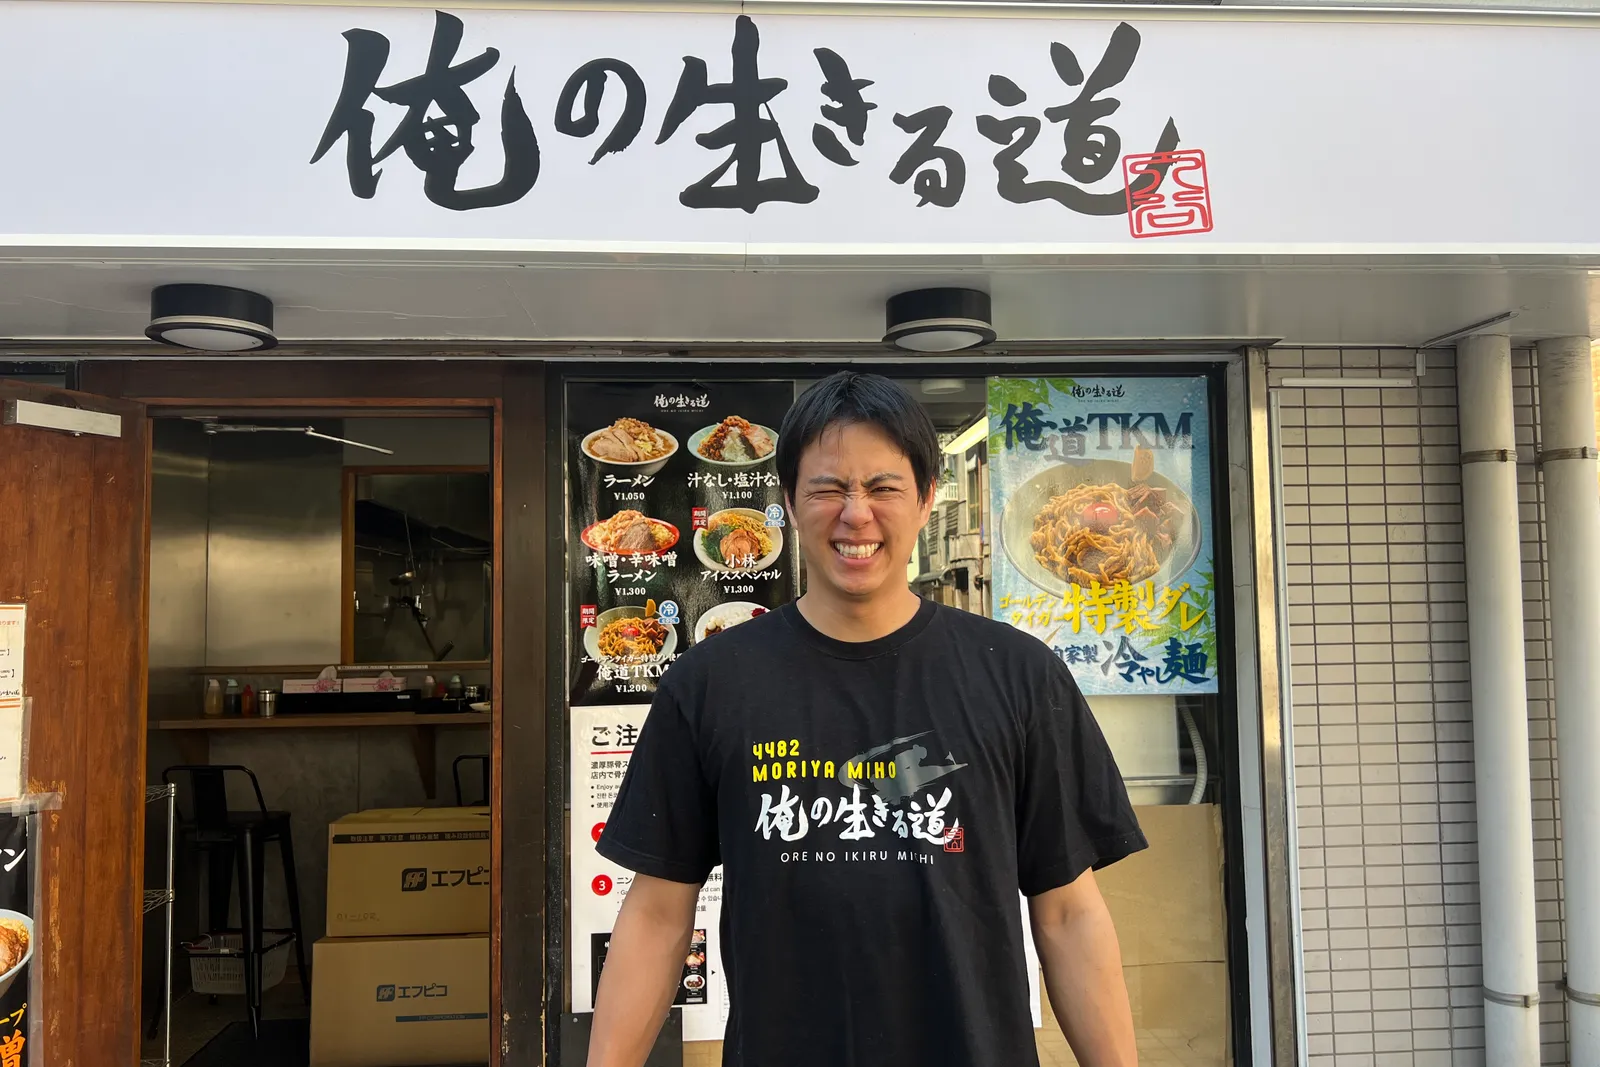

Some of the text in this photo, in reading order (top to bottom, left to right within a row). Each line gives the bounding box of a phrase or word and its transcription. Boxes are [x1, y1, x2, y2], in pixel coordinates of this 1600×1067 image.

[310, 10, 1180, 215] 俺の生きる道
[1071, 383, 1126, 398] 俺の生きる道
[654, 393, 710, 408] 俺の生きる道
[1000, 402, 1196, 467] 俺道TKM
[603, 474, 655, 489] ラーメン
[614, 491, 645, 501] ¥1,050
[722, 491, 753, 500] ¥1,100
[768, 507, 780, 518] 冷
[585, 551, 678, 568] 味噌・辛味噌
[725, 553, 757, 568] 小林
[607, 569, 657, 584] ラーメン
[700, 569, 782, 581] アイススペシャル
[615, 587, 646, 596] ¥1,300
[724, 585, 754, 593] ¥1,300
[999, 592, 1057, 609] ゴールデン
[1063, 580, 1207, 635] 特製ダレ
[663, 604, 674, 616] 冷
[615, 684, 648, 693] ¥1,200
[753, 739, 800, 760] 4482
[752, 760, 897, 782] MORIYA MIHO
[754, 783, 960, 845] 俺の生きる道
[780, 851, 808, 862] ORE
[815, 851, 836, 862] NO
[845, 851, 888, 862] IKIRU
[598, 880, 606, 890] 3
[398, 983, 447, 999] エフピコ
